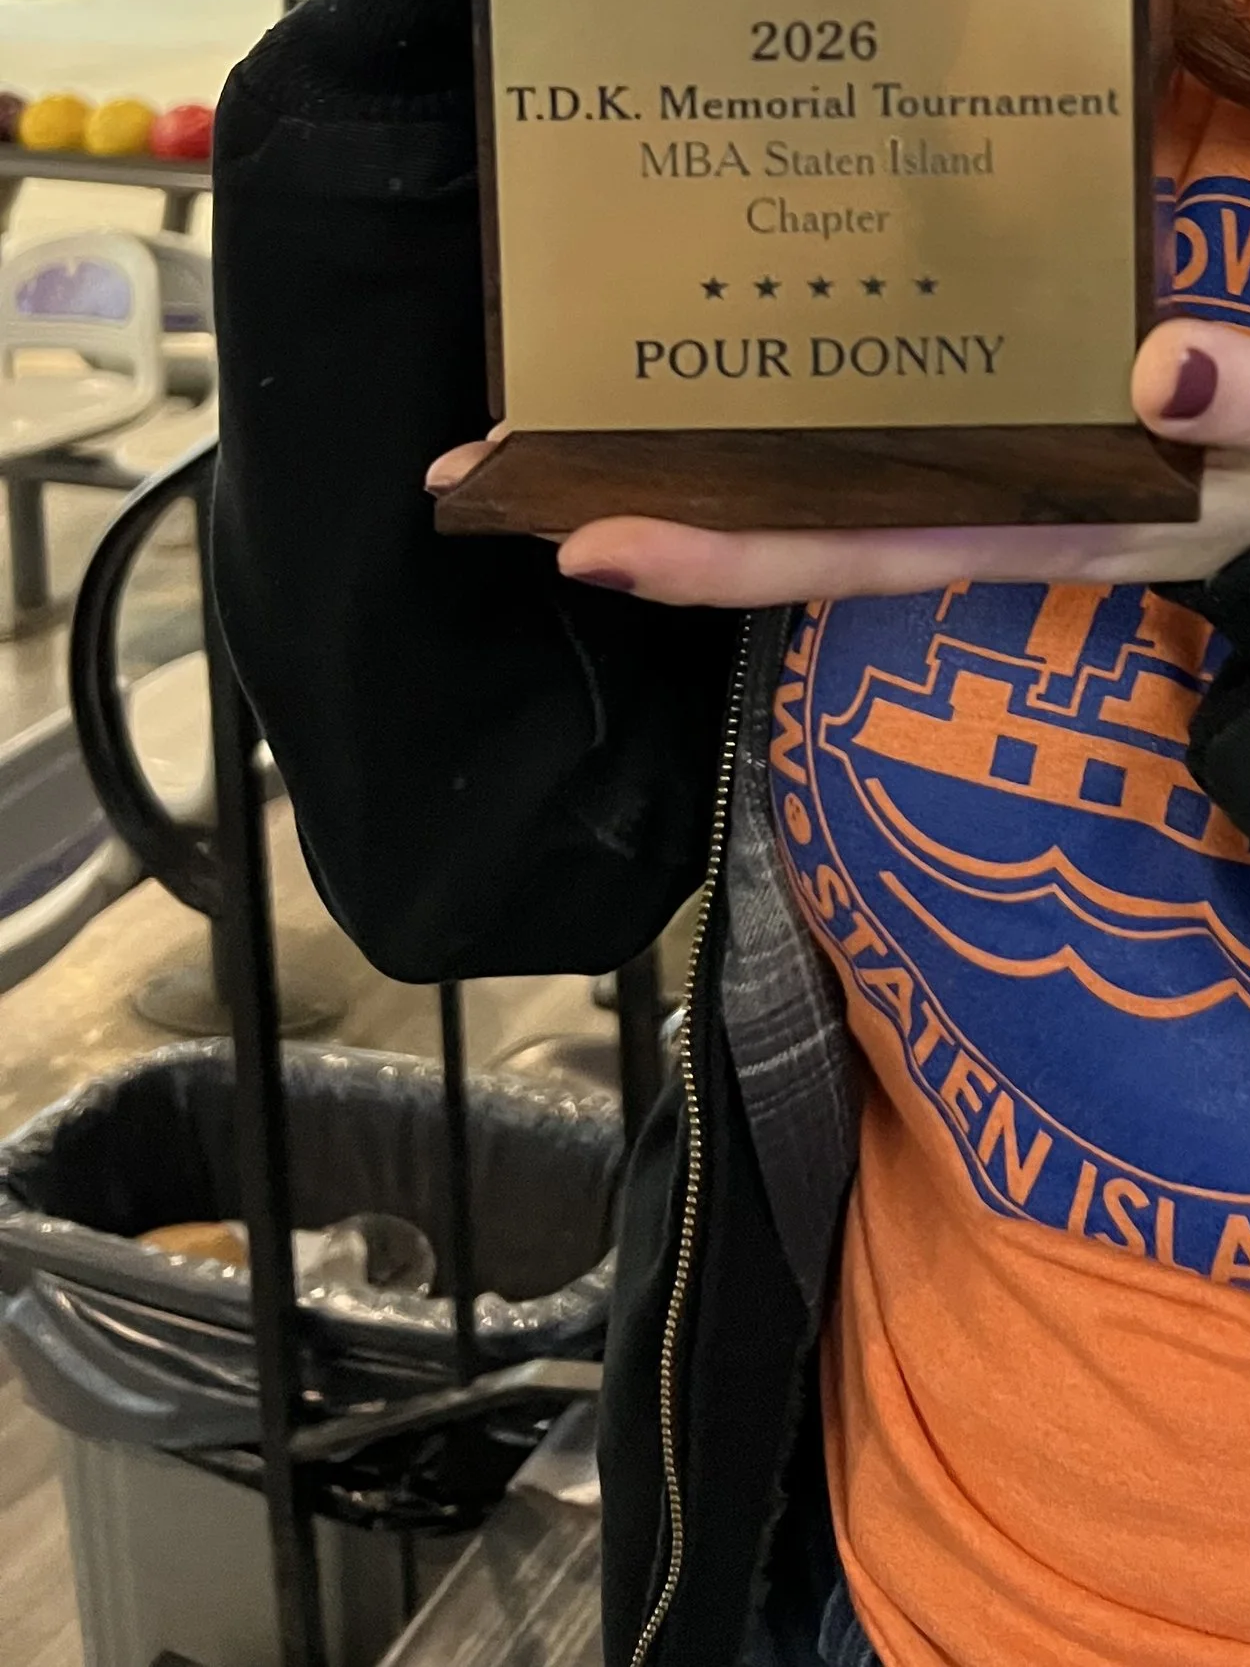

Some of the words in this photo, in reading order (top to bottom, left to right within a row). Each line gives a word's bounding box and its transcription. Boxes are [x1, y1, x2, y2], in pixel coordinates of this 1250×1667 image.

[750, 20, 878, 63] 2026
[506, 85, 642, 122] T.D.K.
[659, 82, 856, 121] Memorial
[871, 82, 1118, 118] Tournament
[639, 141, 752, 179] MBA
[763, 140, 875, 178] Staten
[890, 137, 994, 177] Island
[746, 196, 891, 240] Chapter
[635, 338, 792, 380] POUR
[810, 335, 1005, 377] DONNY
[802, 864, 1053, 1206] STATEN
